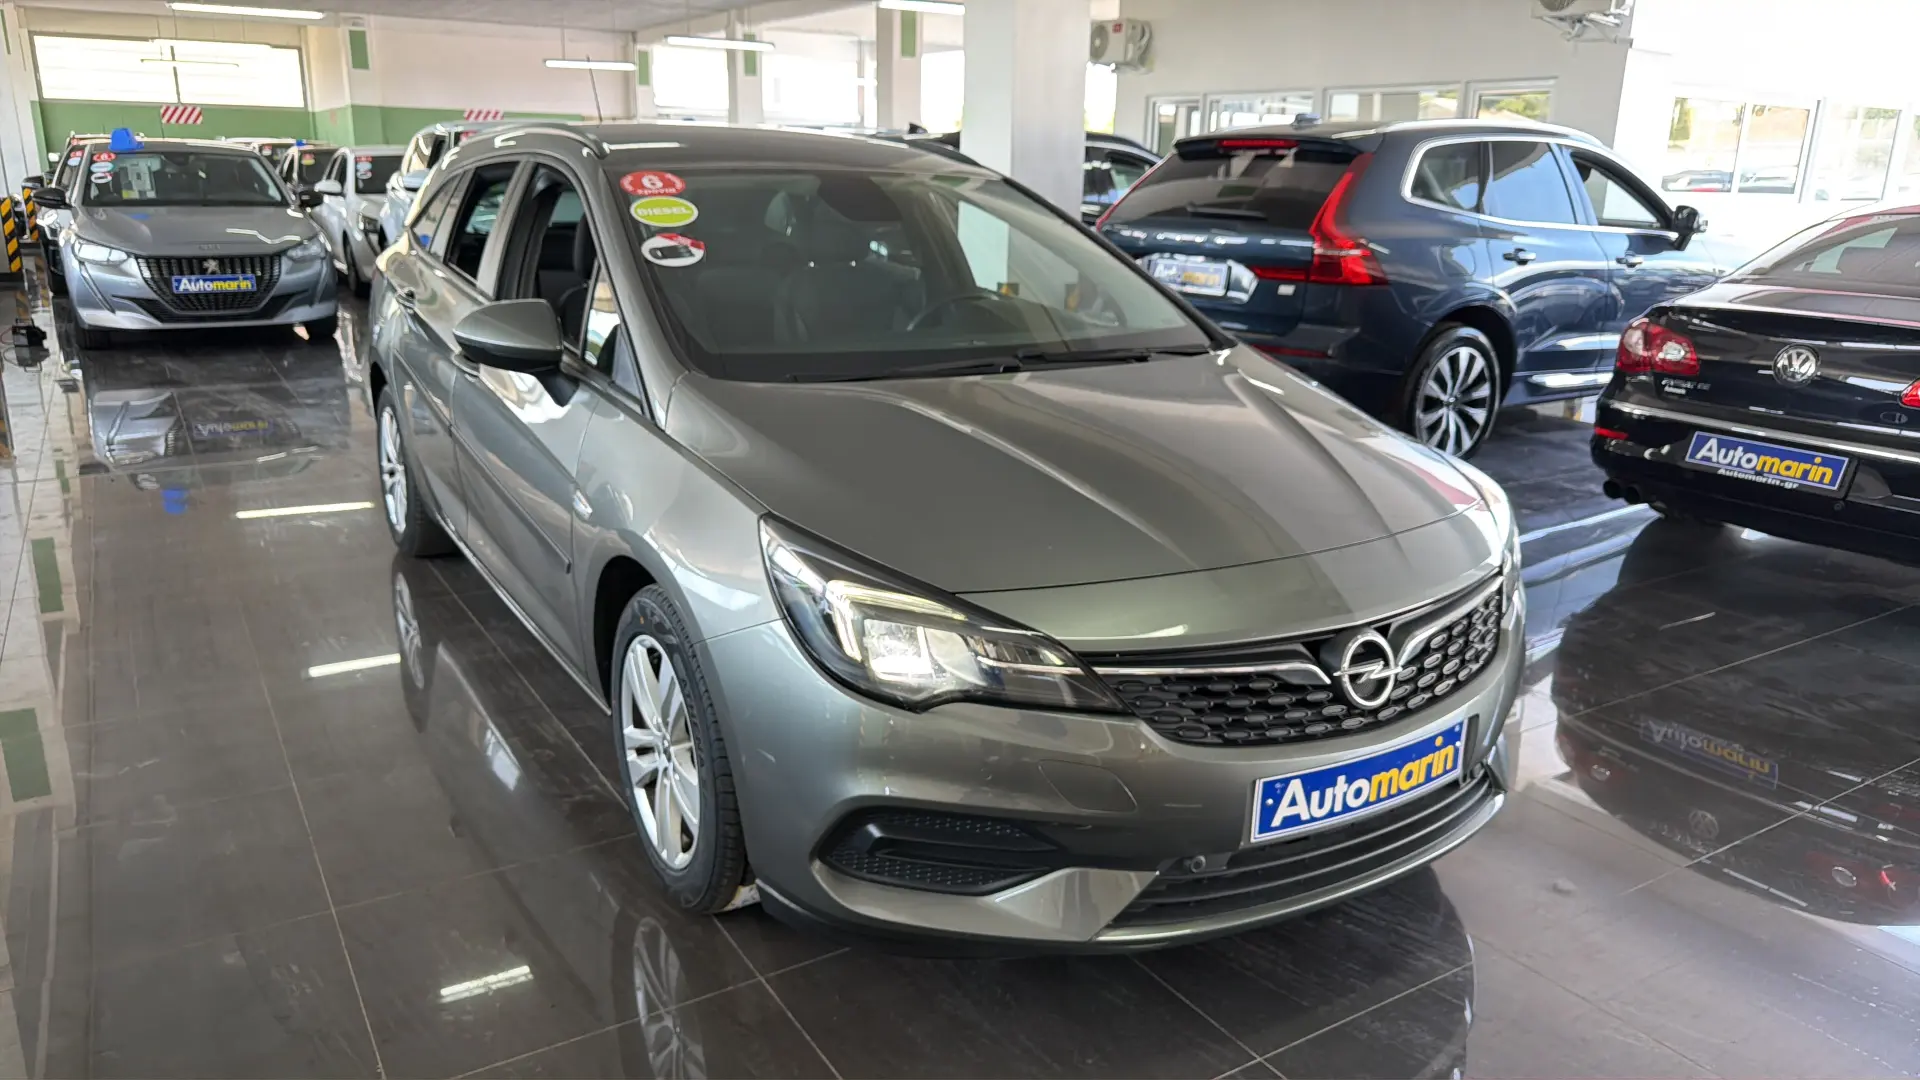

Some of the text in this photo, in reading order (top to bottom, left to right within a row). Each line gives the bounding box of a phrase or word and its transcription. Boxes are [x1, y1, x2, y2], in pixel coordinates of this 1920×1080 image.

[641, 174, 664, 190] 6
[636, 206, 691, 217] DIESEL
[179, 276, 252, 292] Automarin
[1695, 438, 1833, 484] Automarin
[1717, 468, 1799, 489] Automarin.gr
[1270, 735, 1454, 828] Automarin
